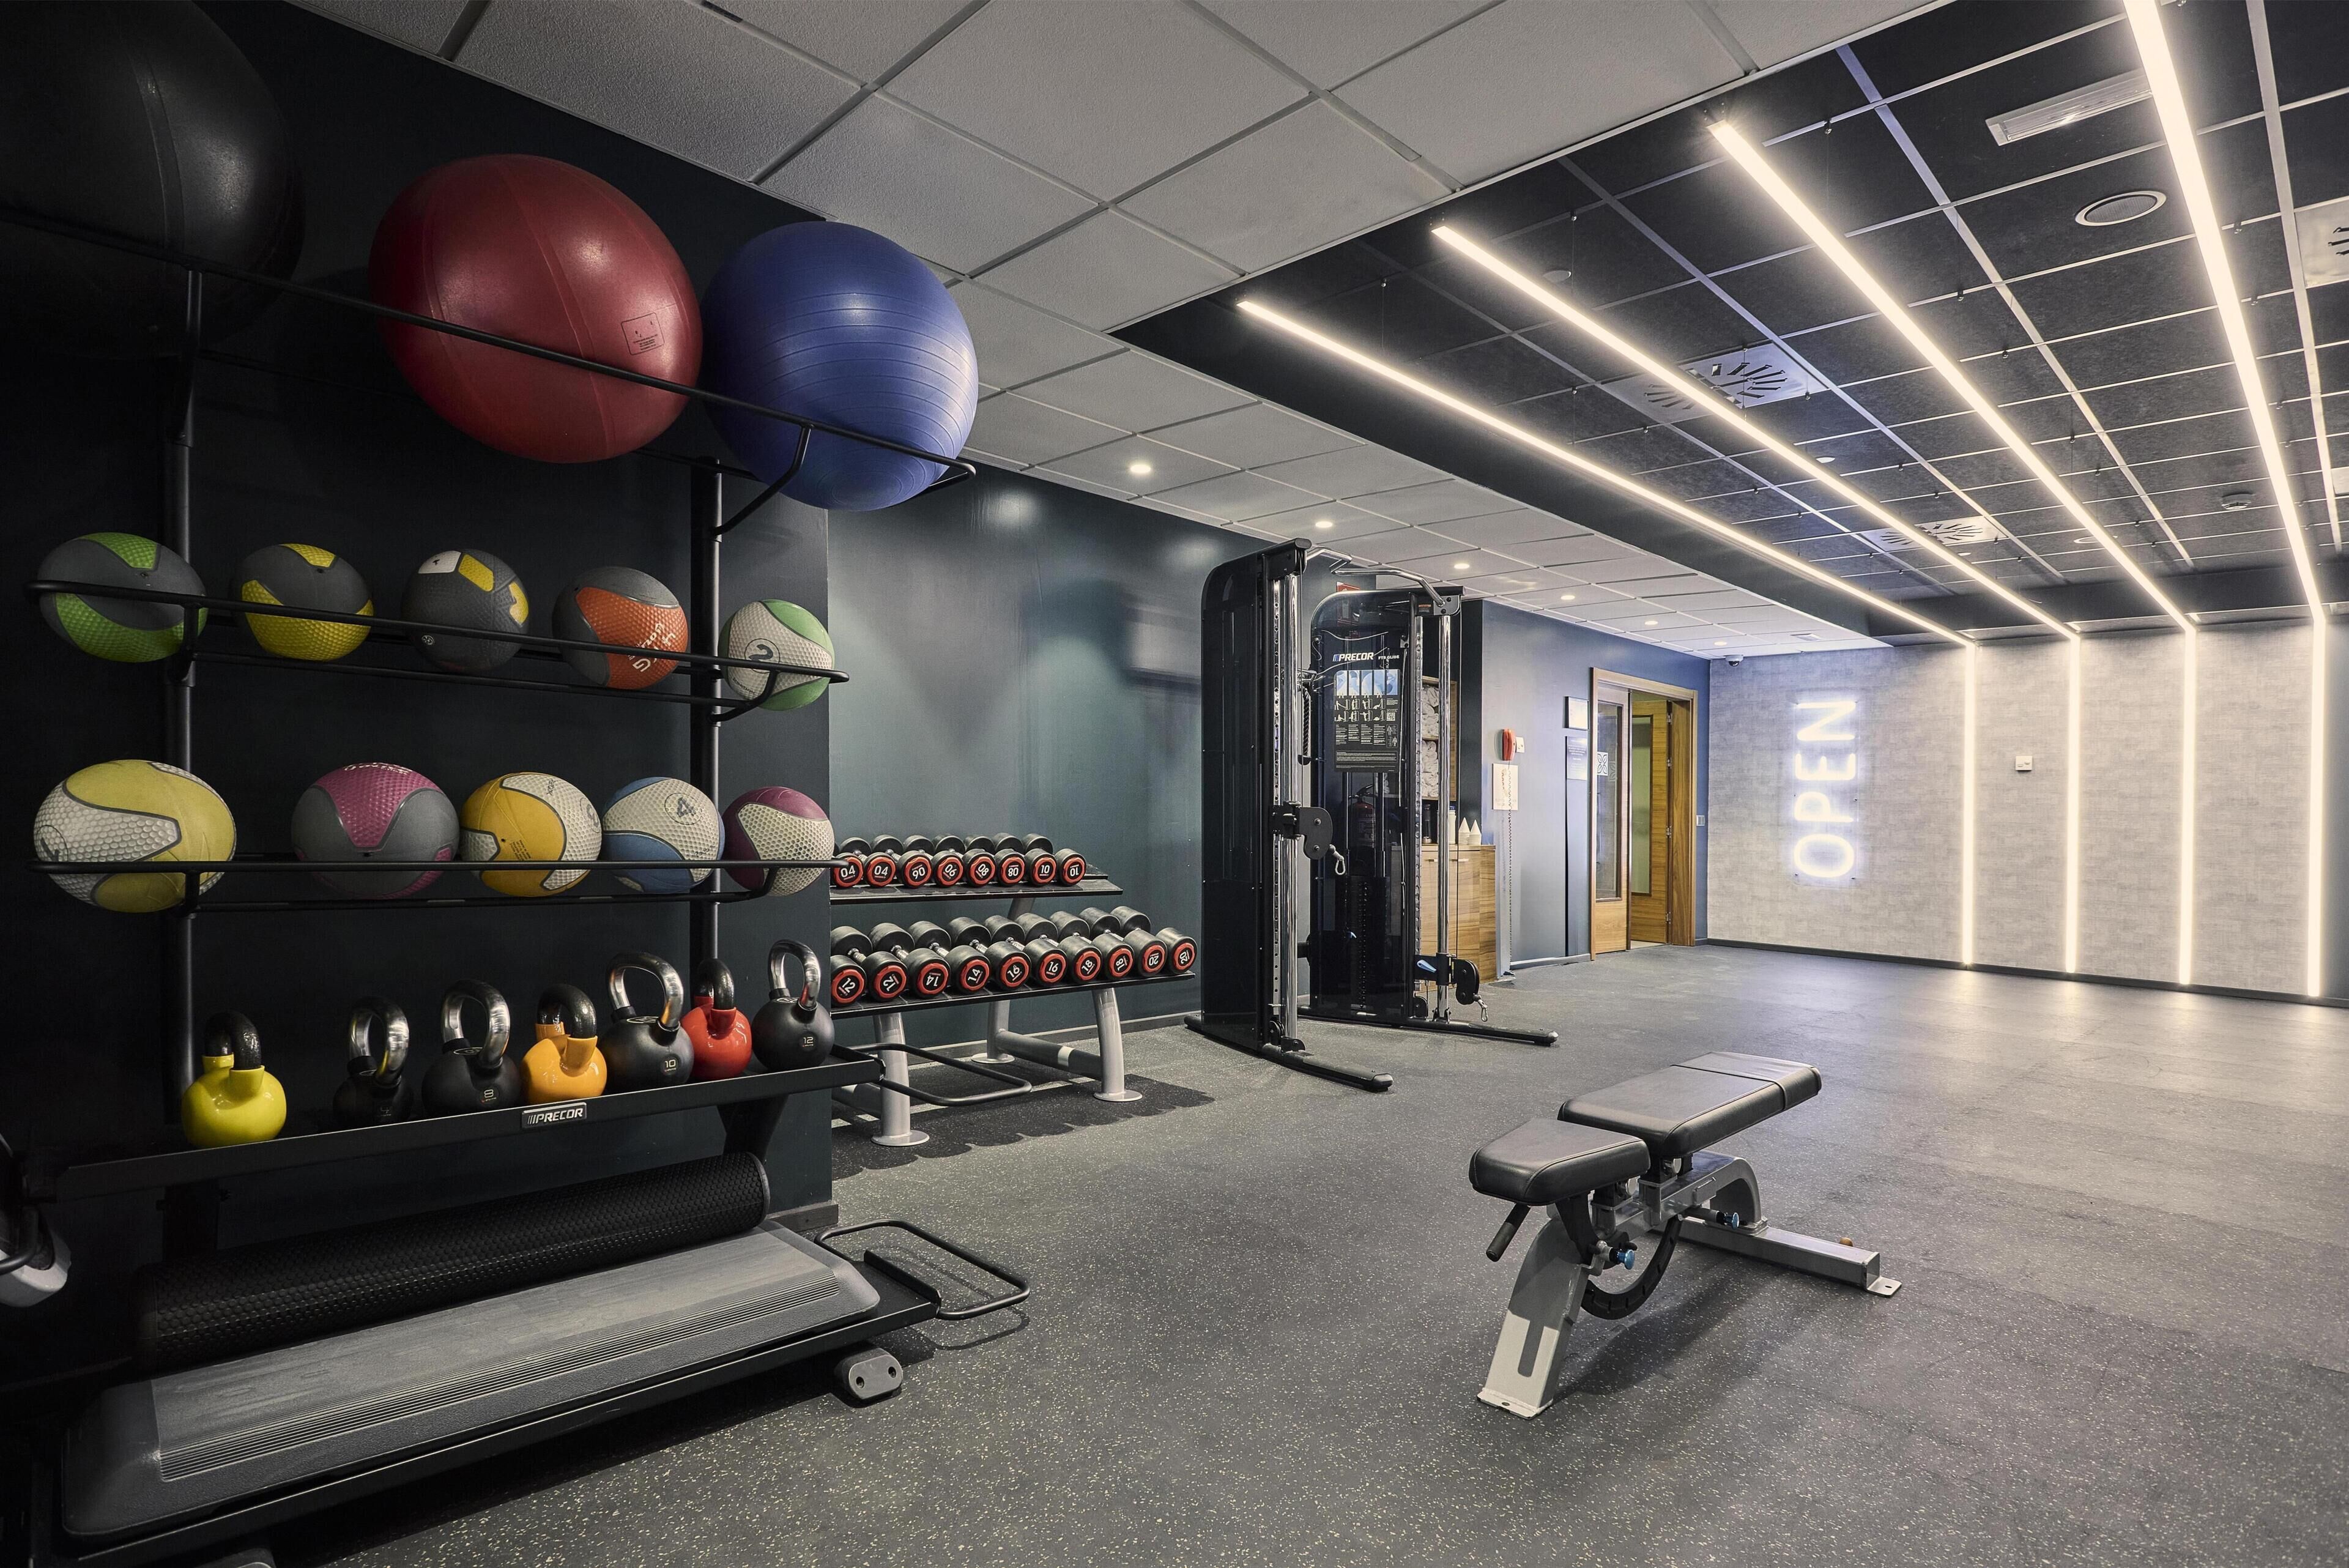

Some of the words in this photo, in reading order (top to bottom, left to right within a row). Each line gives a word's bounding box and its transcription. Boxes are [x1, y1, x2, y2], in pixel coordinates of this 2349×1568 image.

[1338, 652, 1374, 661] PRECOR
[1794, 701, 1856, 878] OPEN
[677, 797, 696, 816] 4
[841, 865, 855, 878] 04
[874, 865, 888, 876] 04
[912, 866, 926, 879] 06
[944, 864, 957, 877] 06
[978, 863, 989, 877] 08
[1008, 867, 1019, 877] 08
[1041, 864, 1050, 874] 10
[1070, 867, 1079, 877] 10
[1149, 956, 1159, 966] 20
[1179, 951, 1189, 964] 20
[1048, 961, 1059, 973] 16
[1081, 959, 1093, 972] 18
[1116, 958, 1125, 971] 18
[968, 968, 981, 981] 14
[1007, 964, 1020, 979] 16
[842, 978, 856, 994] 12
[883, 976, 896, 992] 12
[926, 975, 940, 987] 14
[665, 1059, 676, 1068] 10
[484, 1089, 494, 1098] 8
[535, 1108, 584, 1124] PRECOR
